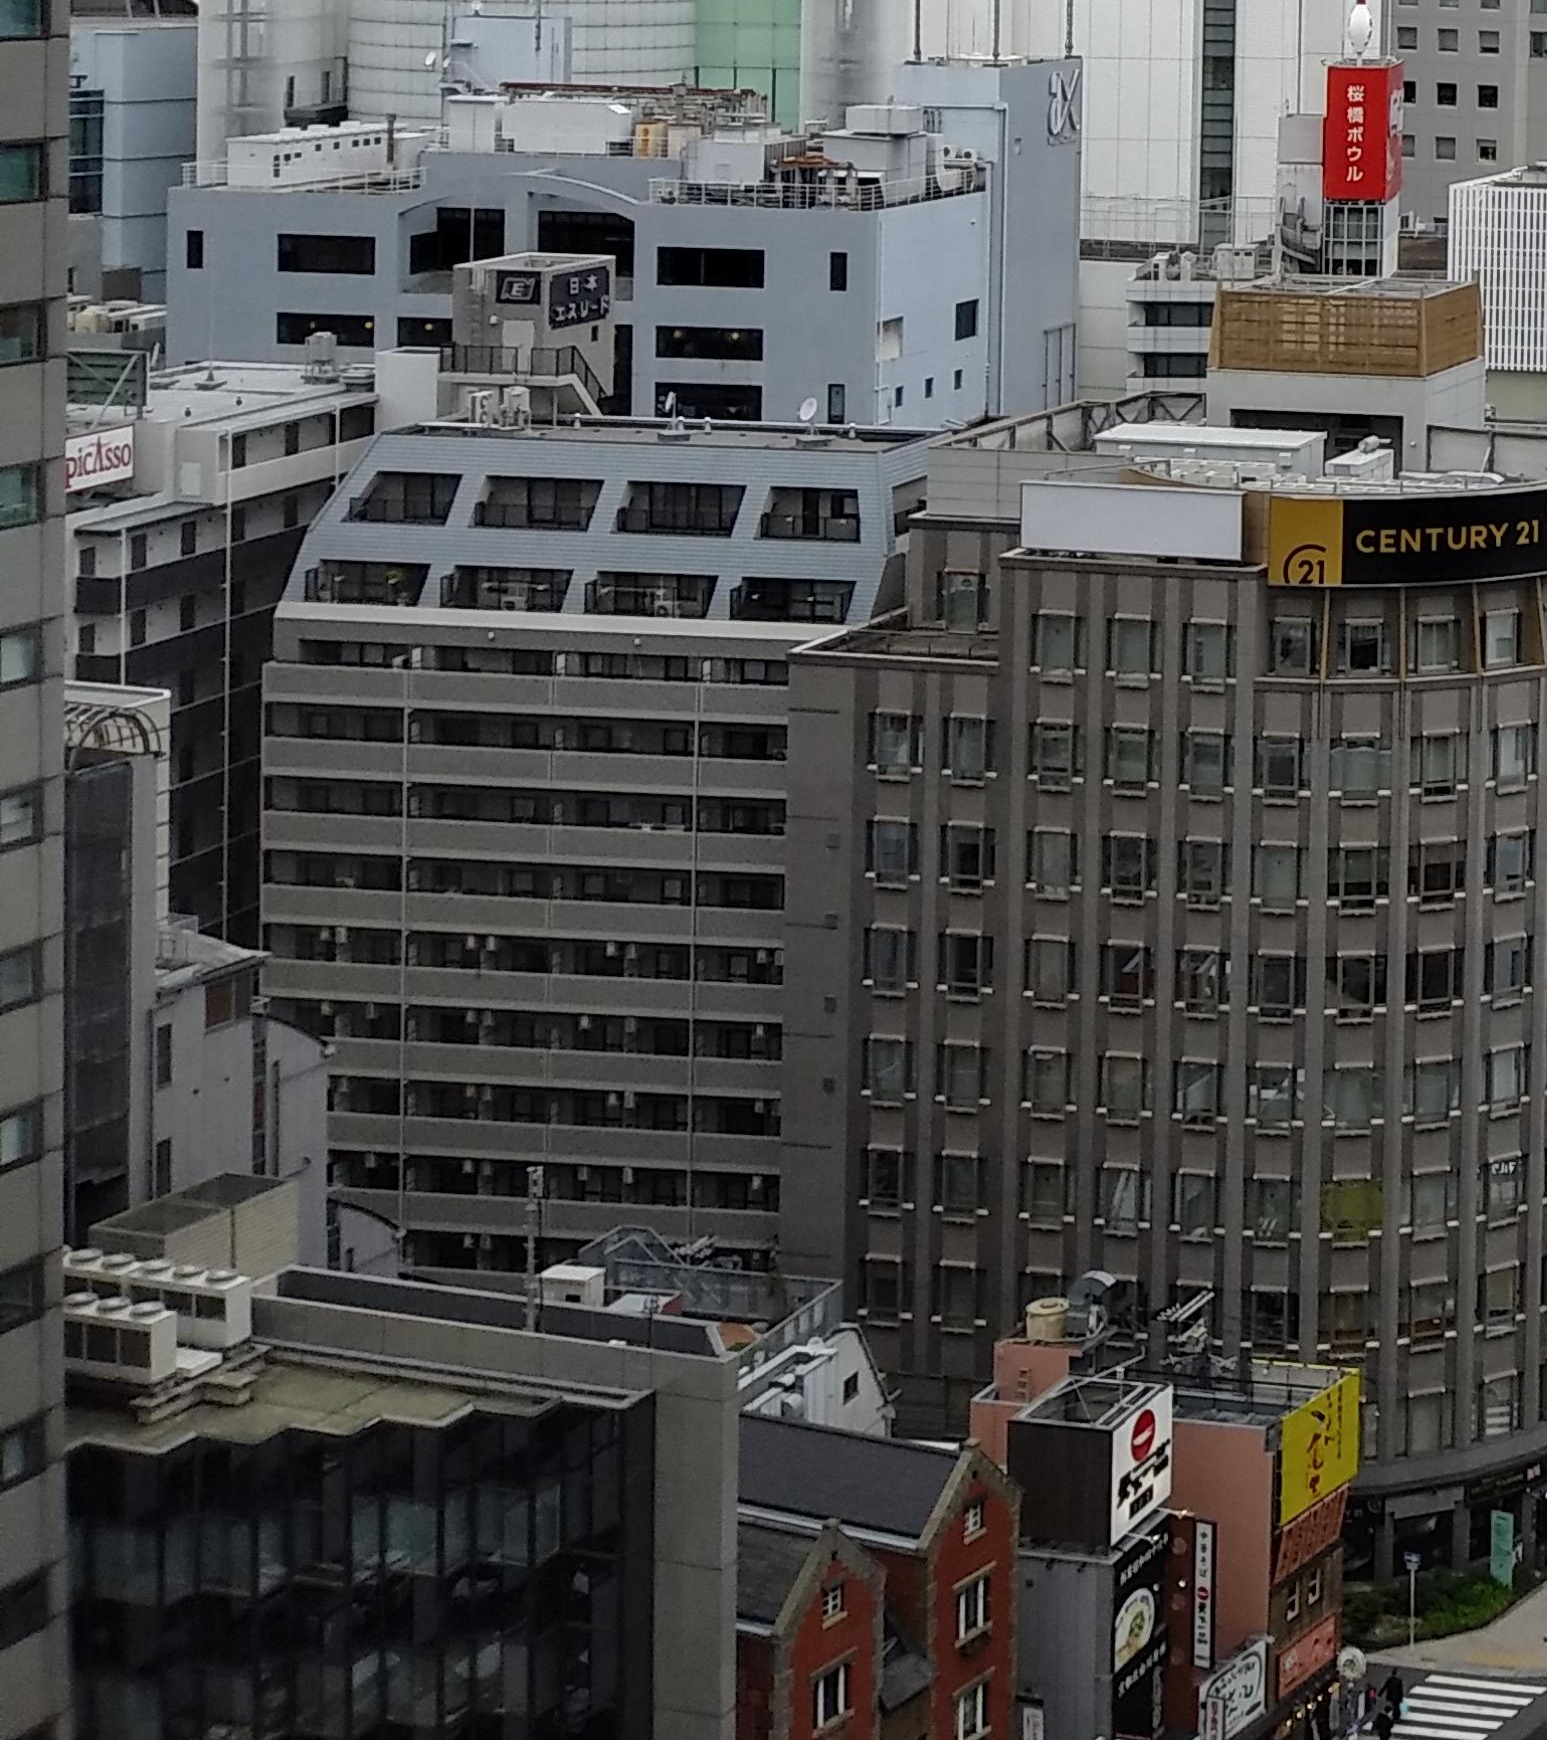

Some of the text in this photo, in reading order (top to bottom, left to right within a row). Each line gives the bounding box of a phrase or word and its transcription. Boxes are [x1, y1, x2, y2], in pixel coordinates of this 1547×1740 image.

[1346, 85, 1365, 182] 桜橋ボウル
[568, 274, 598, 295] 日本
[1355, 518, 1540, 556] CENTURY 21
